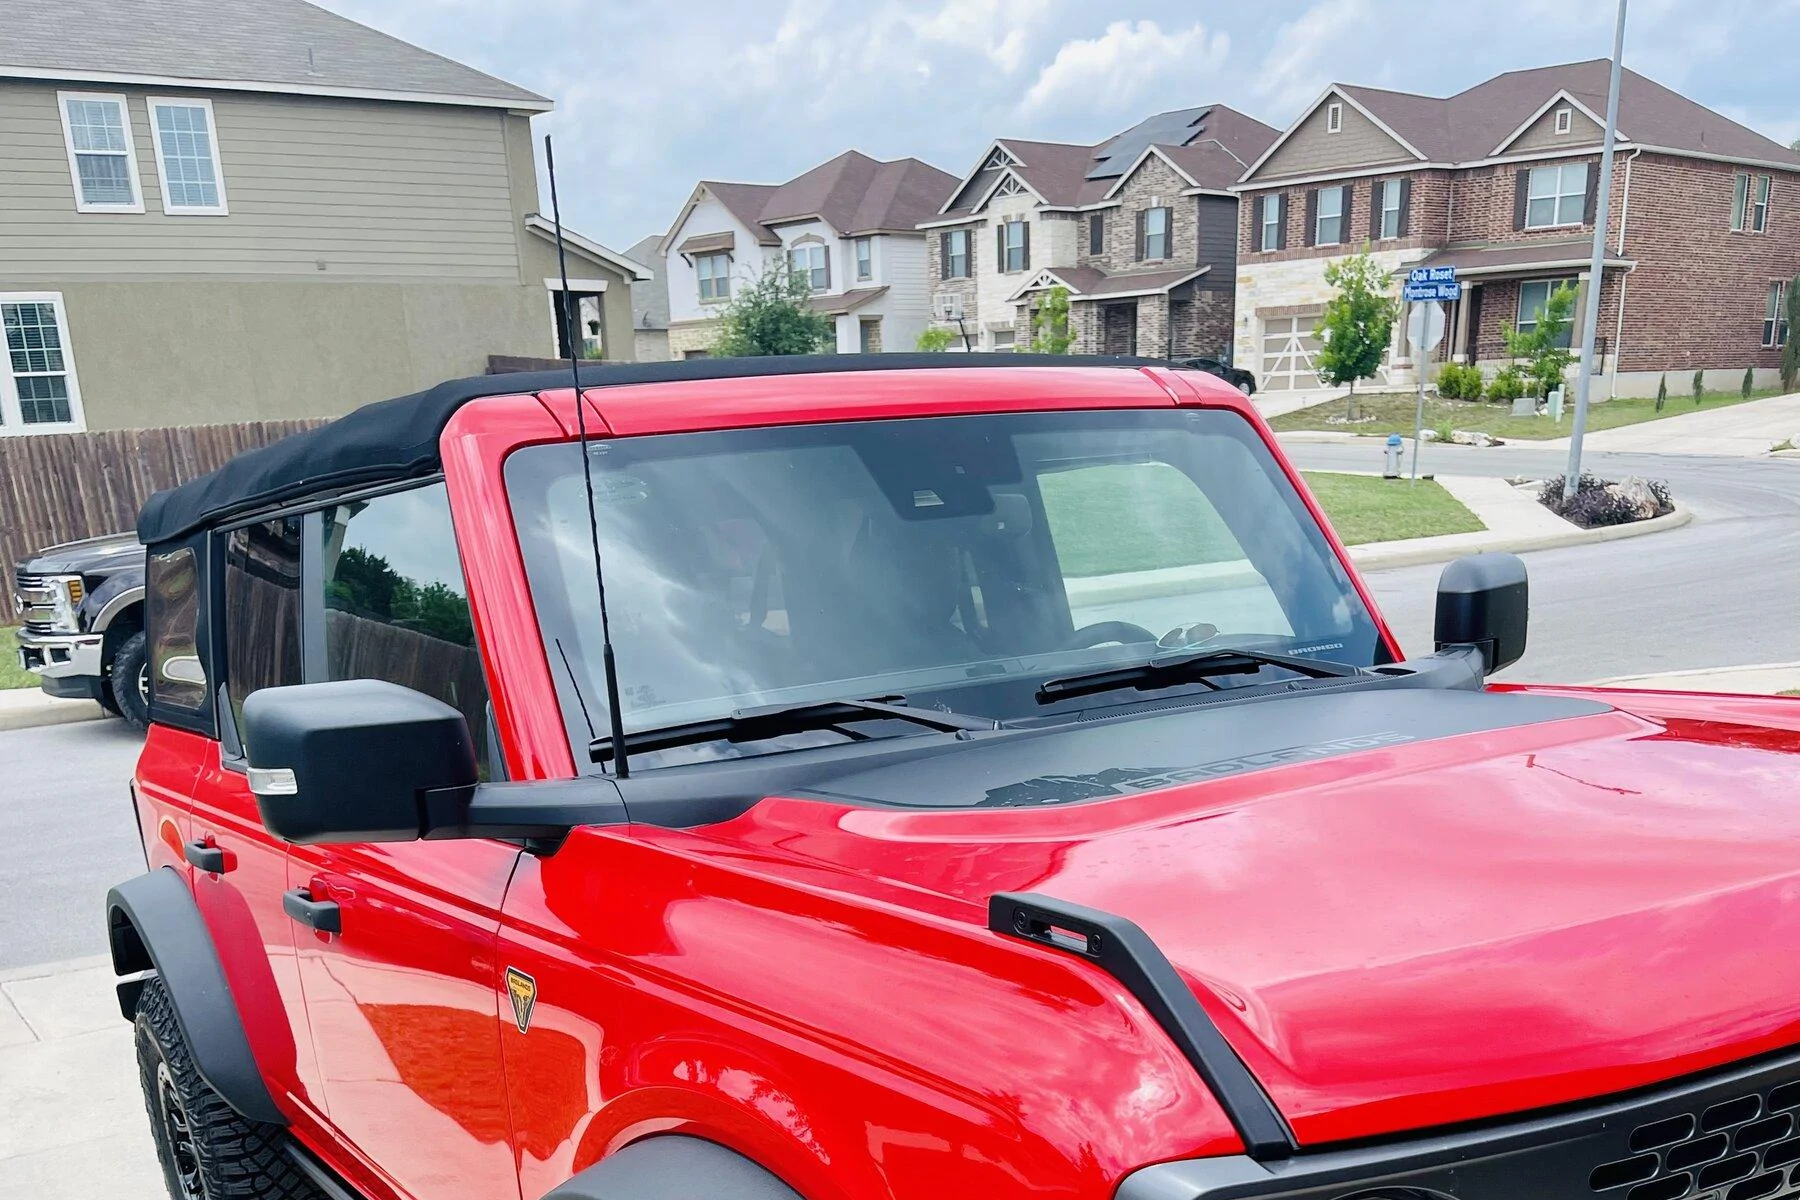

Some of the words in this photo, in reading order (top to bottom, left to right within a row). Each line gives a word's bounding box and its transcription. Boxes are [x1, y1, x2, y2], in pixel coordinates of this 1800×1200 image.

[1411, 268, 1428, 281] Oak
[1288, 643, 1343, 655] BRONCO
[1125, 731, 1415, 790] BADLANDS
